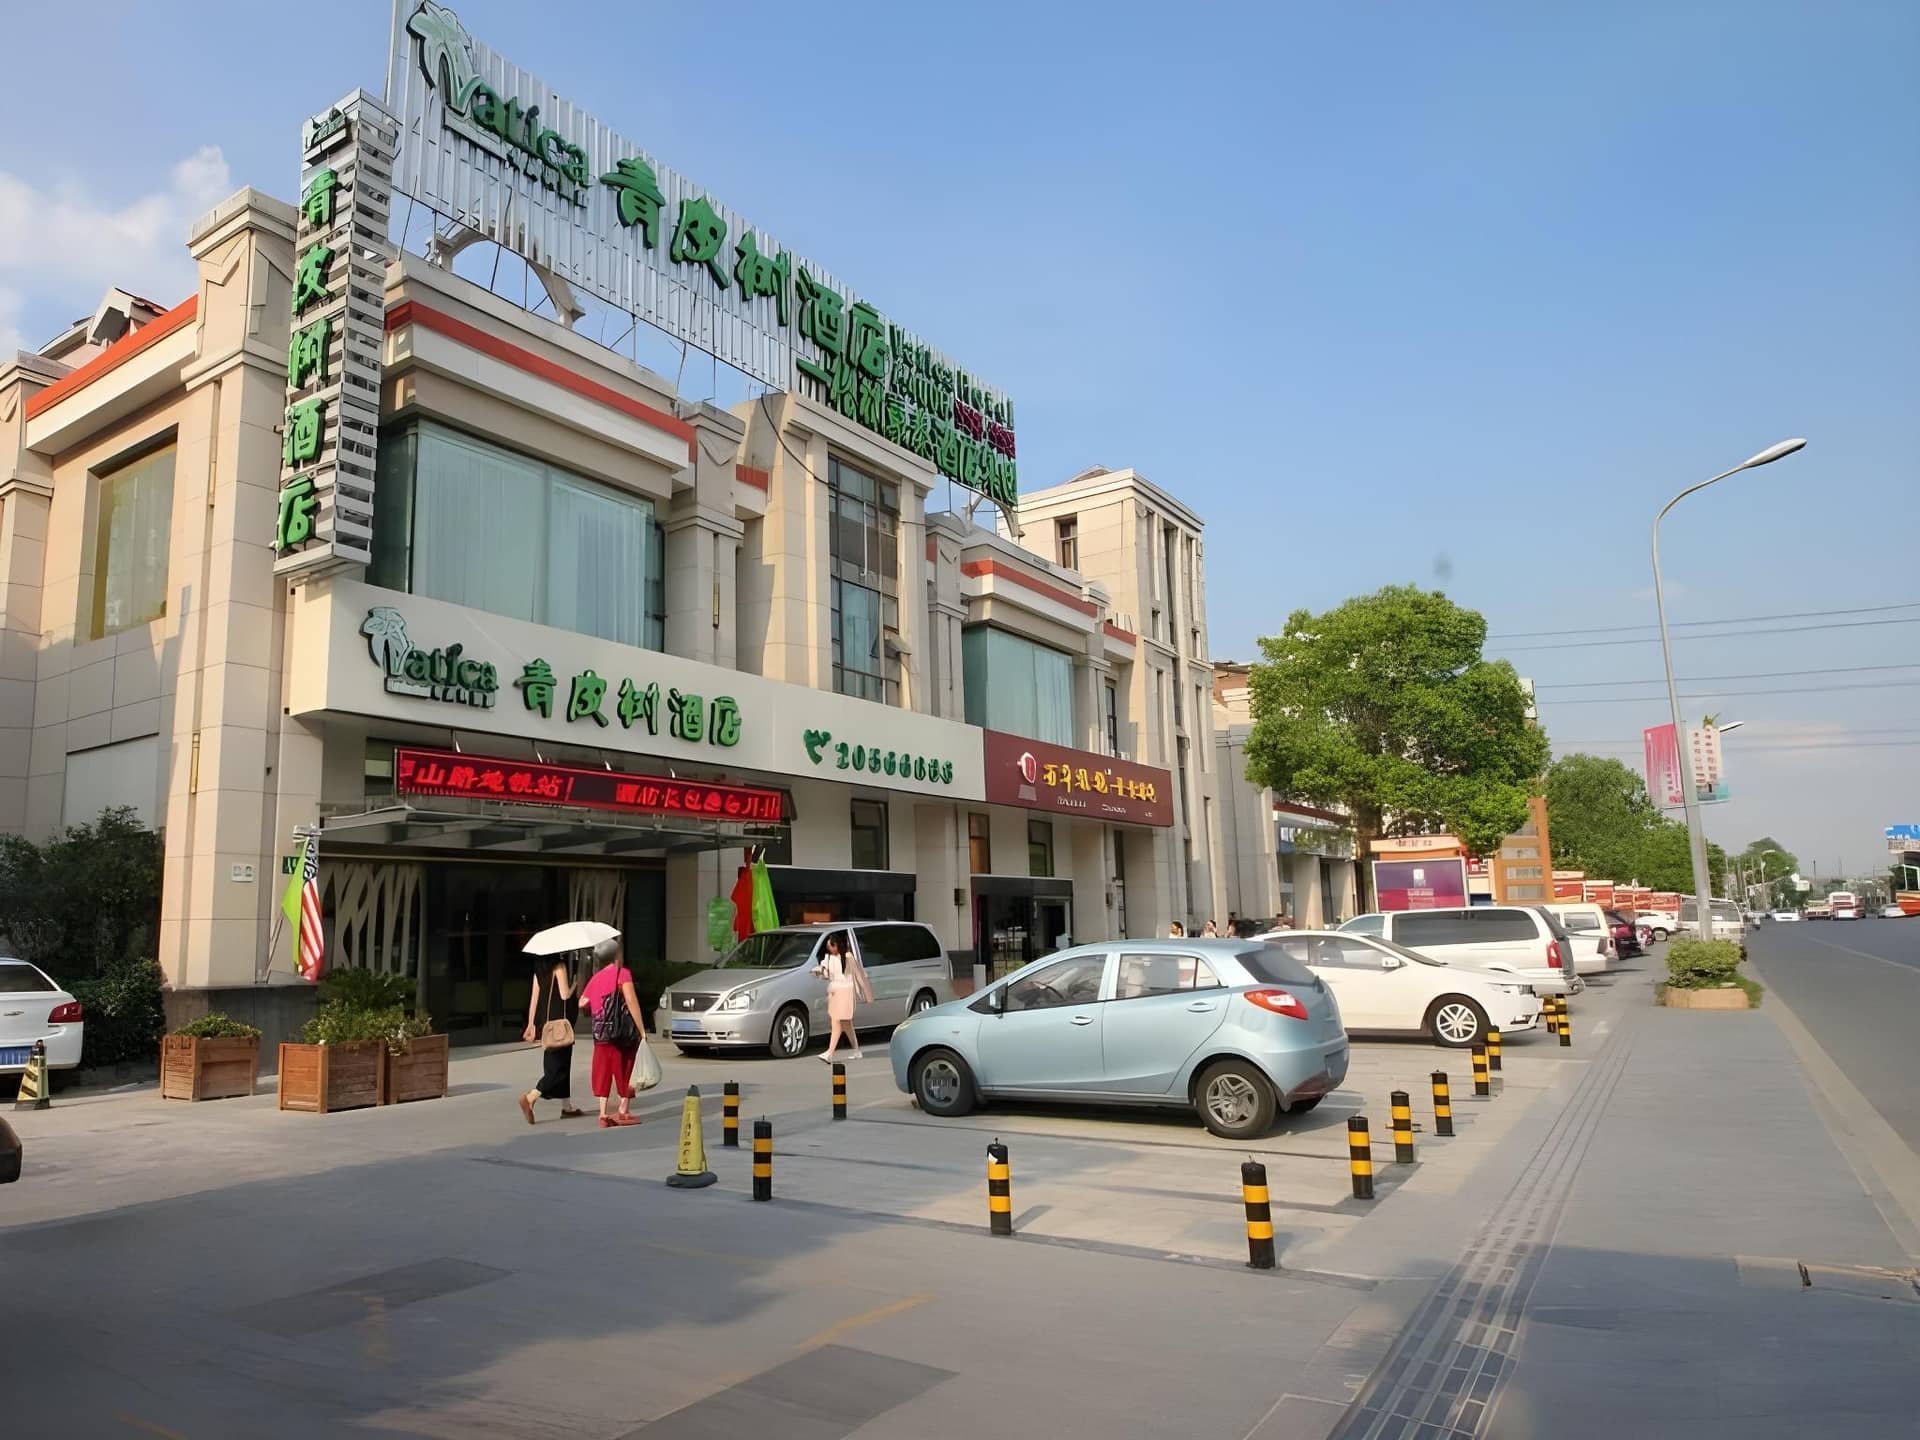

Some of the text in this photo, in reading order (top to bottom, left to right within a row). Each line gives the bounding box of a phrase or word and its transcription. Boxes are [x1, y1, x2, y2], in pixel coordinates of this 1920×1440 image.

[278, 168, 338, 551] 青皮树酒店
[601, 157, 889, 380] 青皮树酒店
[516, 658, 742, 747] 青皮树酒店
